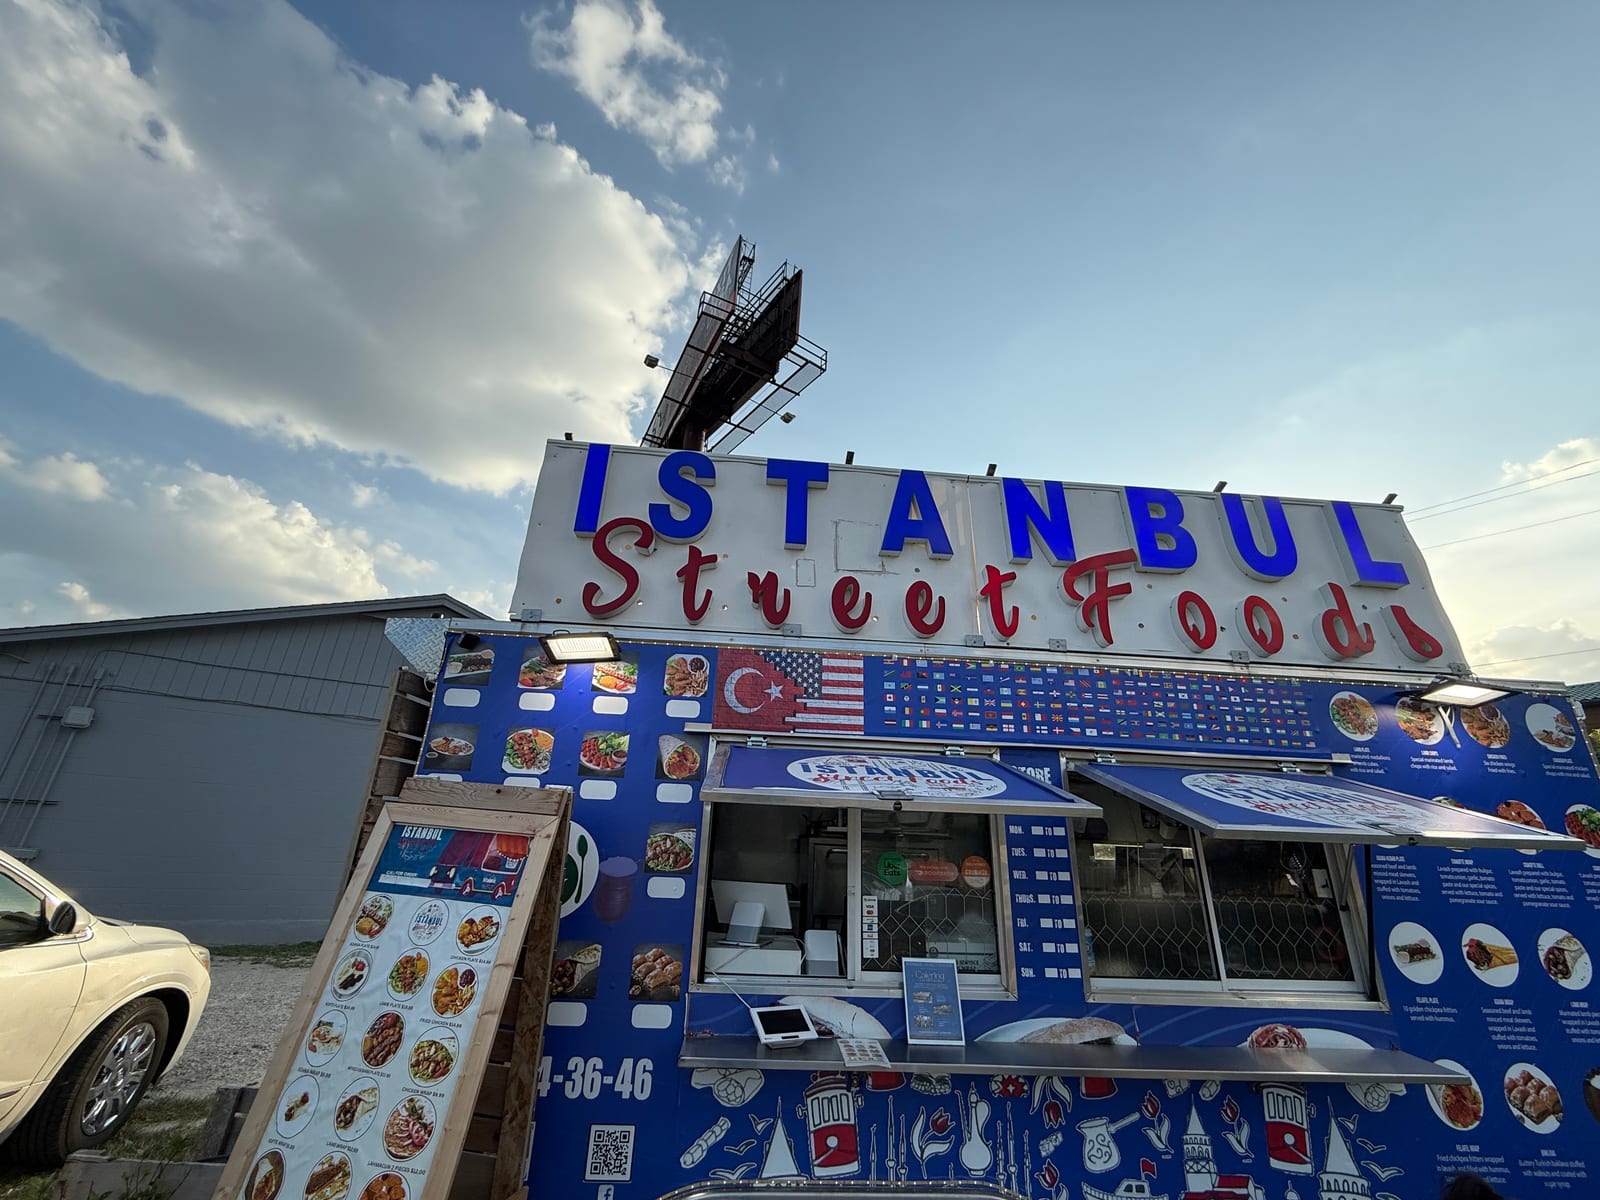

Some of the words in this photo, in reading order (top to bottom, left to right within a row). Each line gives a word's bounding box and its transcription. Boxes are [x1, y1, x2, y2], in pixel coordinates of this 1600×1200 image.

[574, 443, 1410, 588] ISTANBUL
[582, 517, 1020, 641] Street
[1058, 548, 1443, 661] Foods
[537, 1055, 654, 1101] 4-36-46
